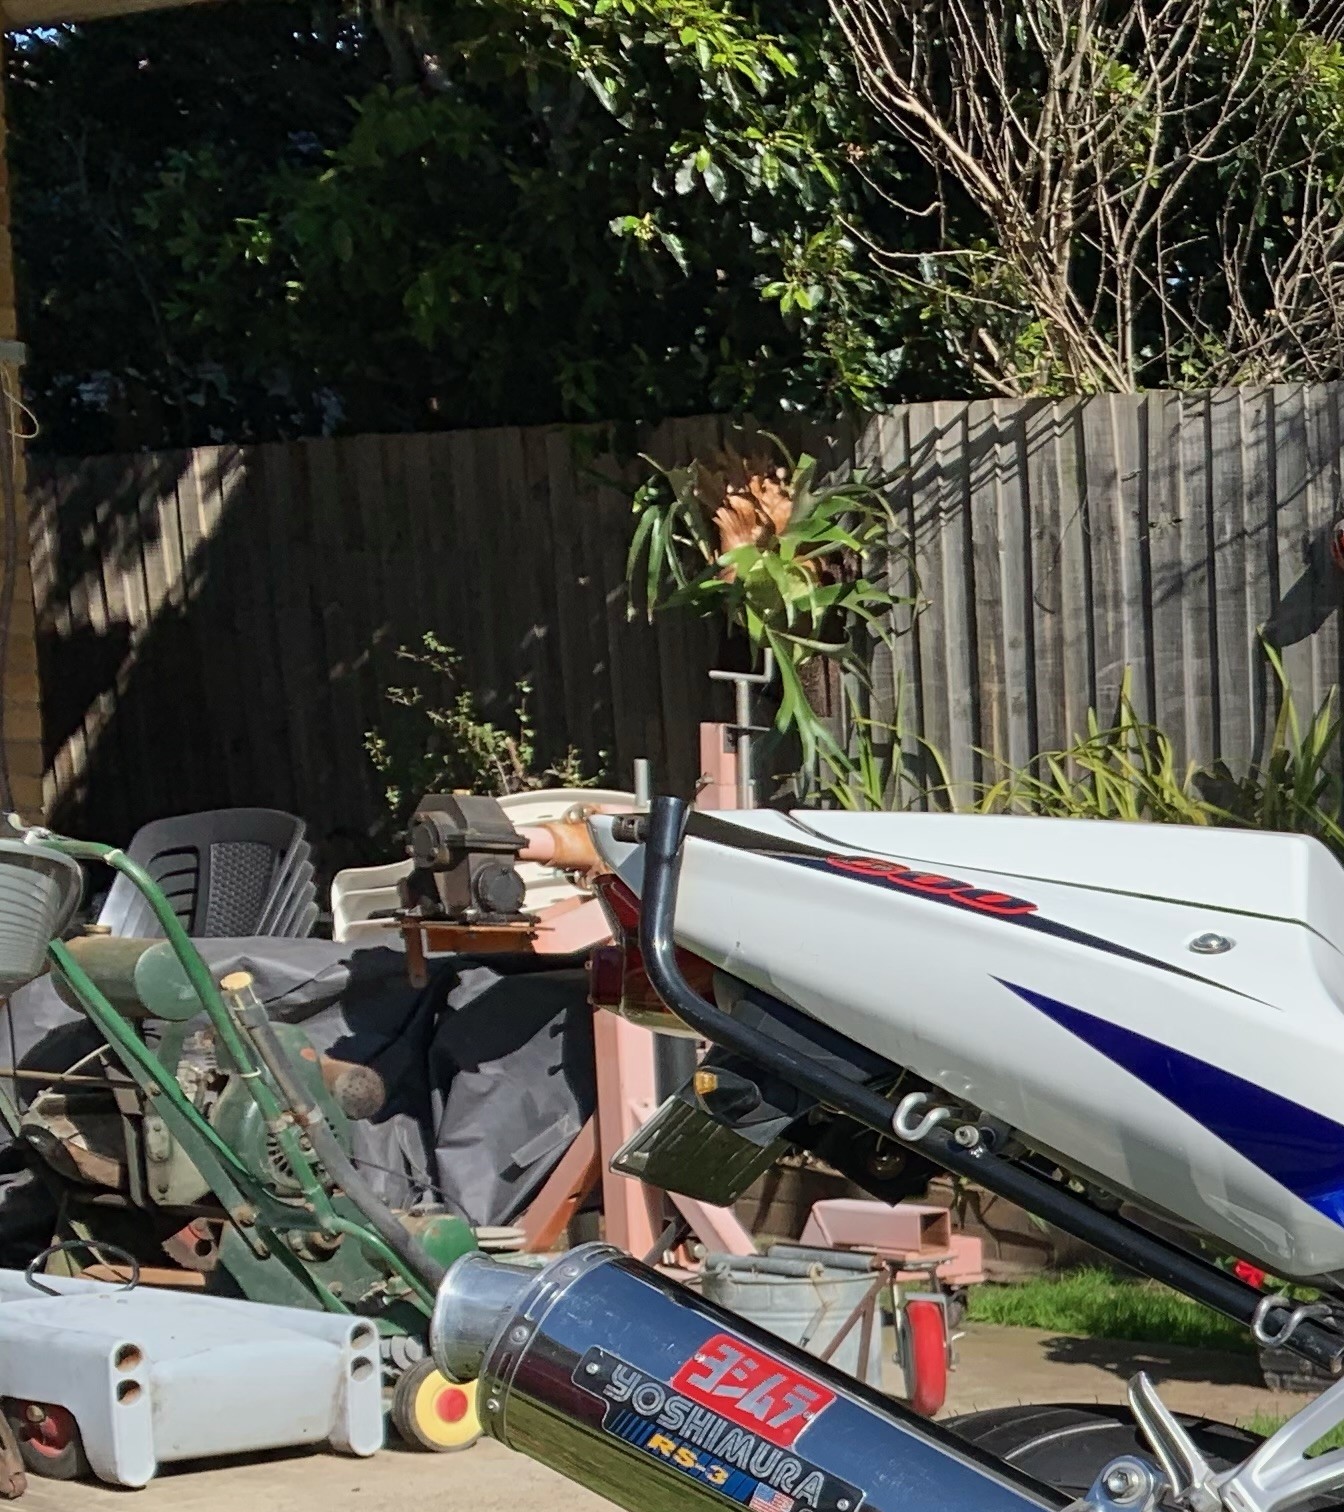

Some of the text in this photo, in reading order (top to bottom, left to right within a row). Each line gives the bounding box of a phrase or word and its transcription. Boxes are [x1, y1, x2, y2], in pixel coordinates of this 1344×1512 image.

[686, 1344, 822, 1429] ヨシムラ
[603, 1363, 826, 1509] YOSHIMURA
[646, 1433, 729, 1485] RS-3
